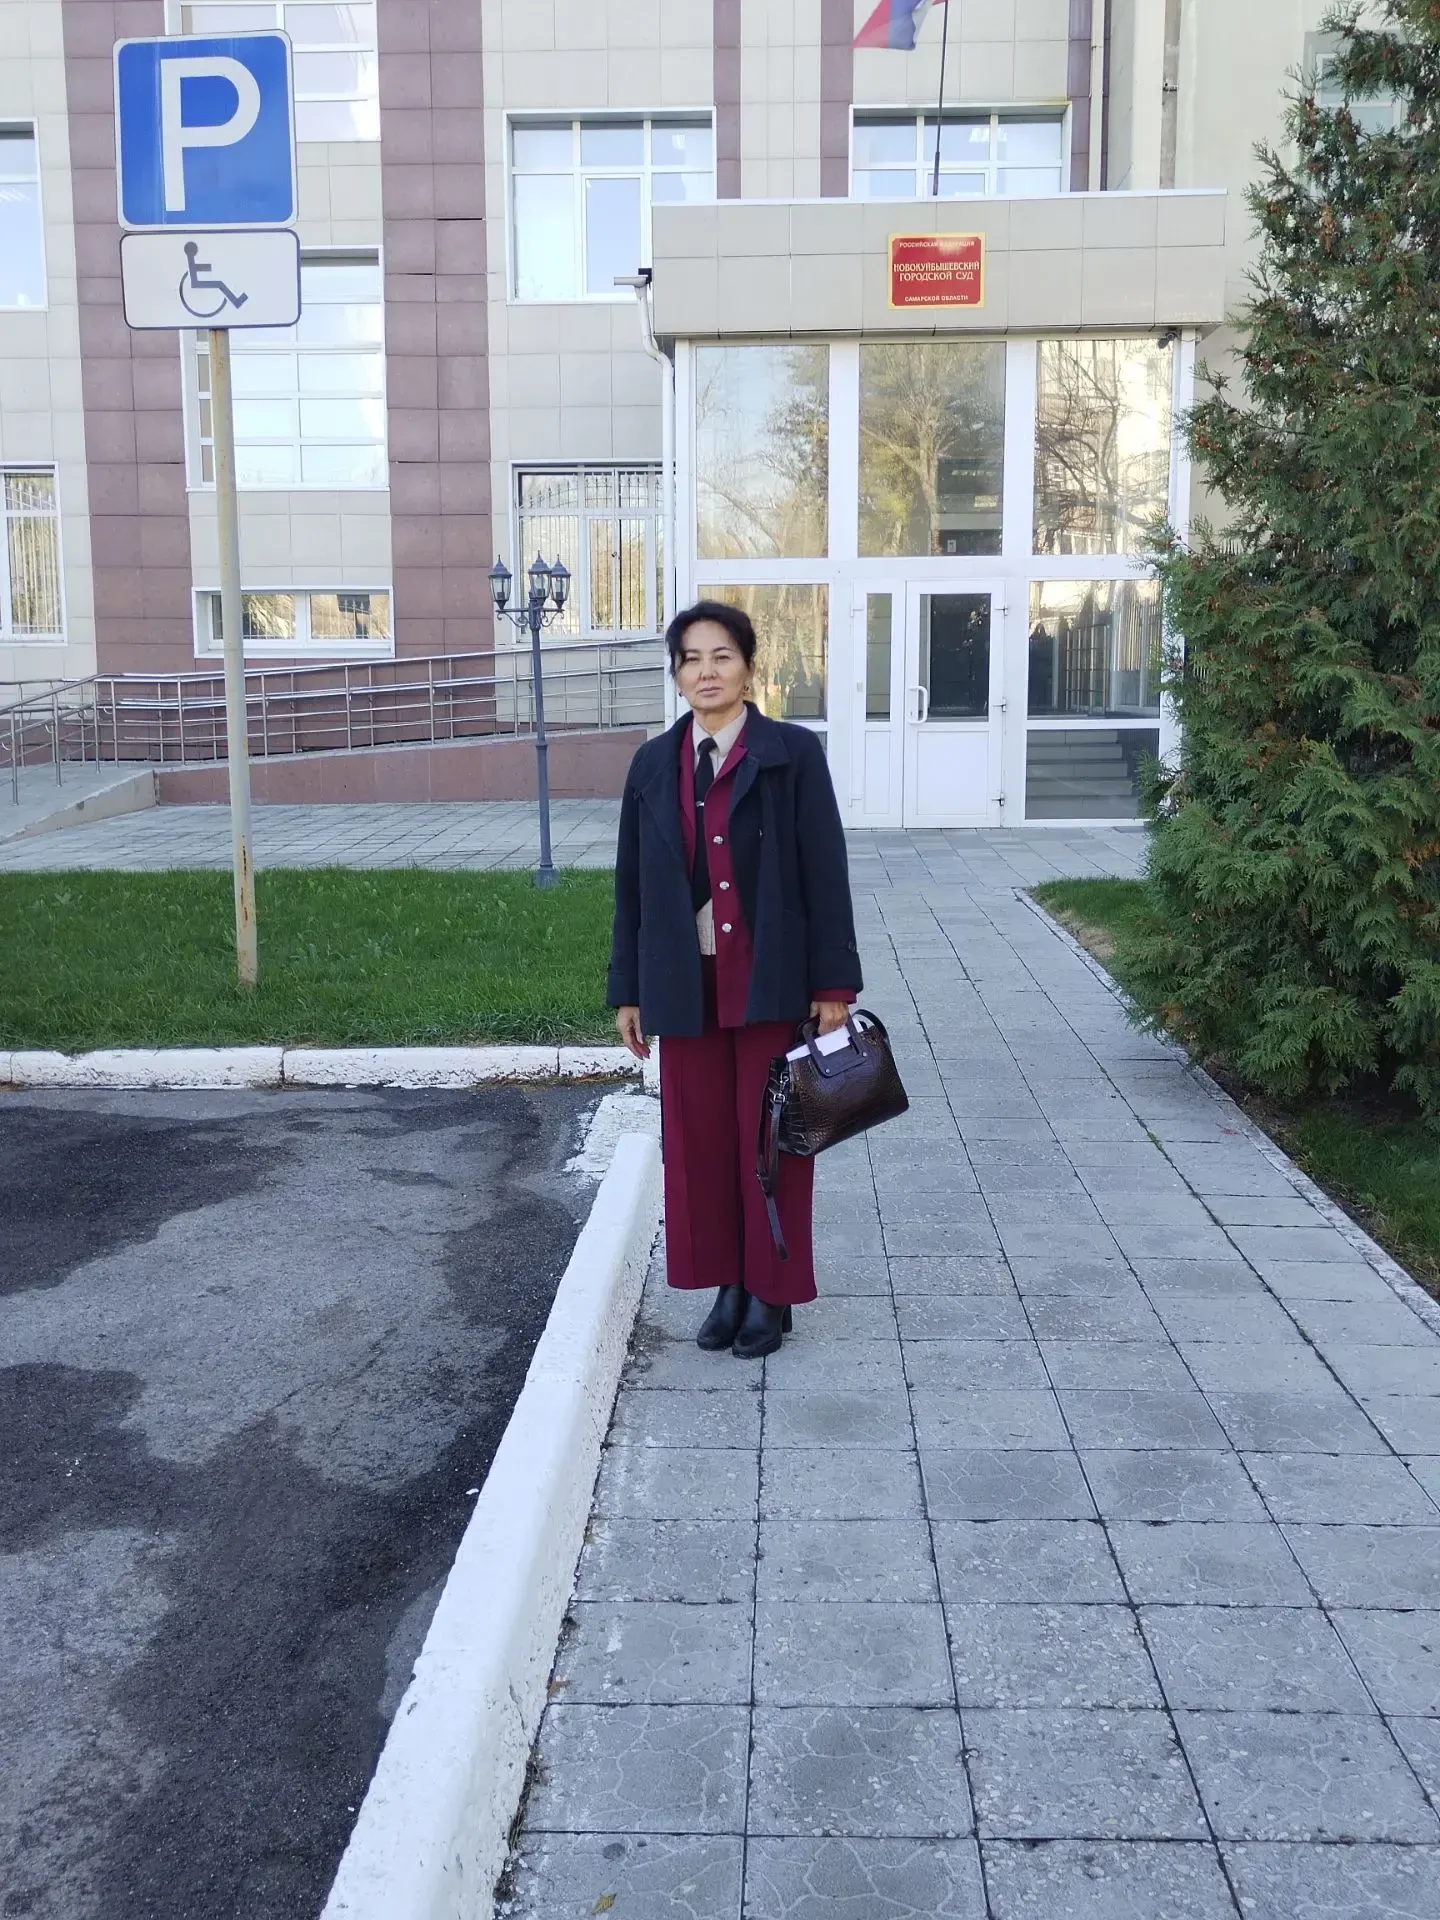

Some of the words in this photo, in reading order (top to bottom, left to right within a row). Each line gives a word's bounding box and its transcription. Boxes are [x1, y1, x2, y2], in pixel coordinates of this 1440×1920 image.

[160, 56, 261, 212] P
[893, 261, 980, 272] НОВОКУЙБЫШЕВСКИЙ
[899, 271, 952, 281] ГОРОДСКОЙ
[955, 271, 974, 280] СУД
